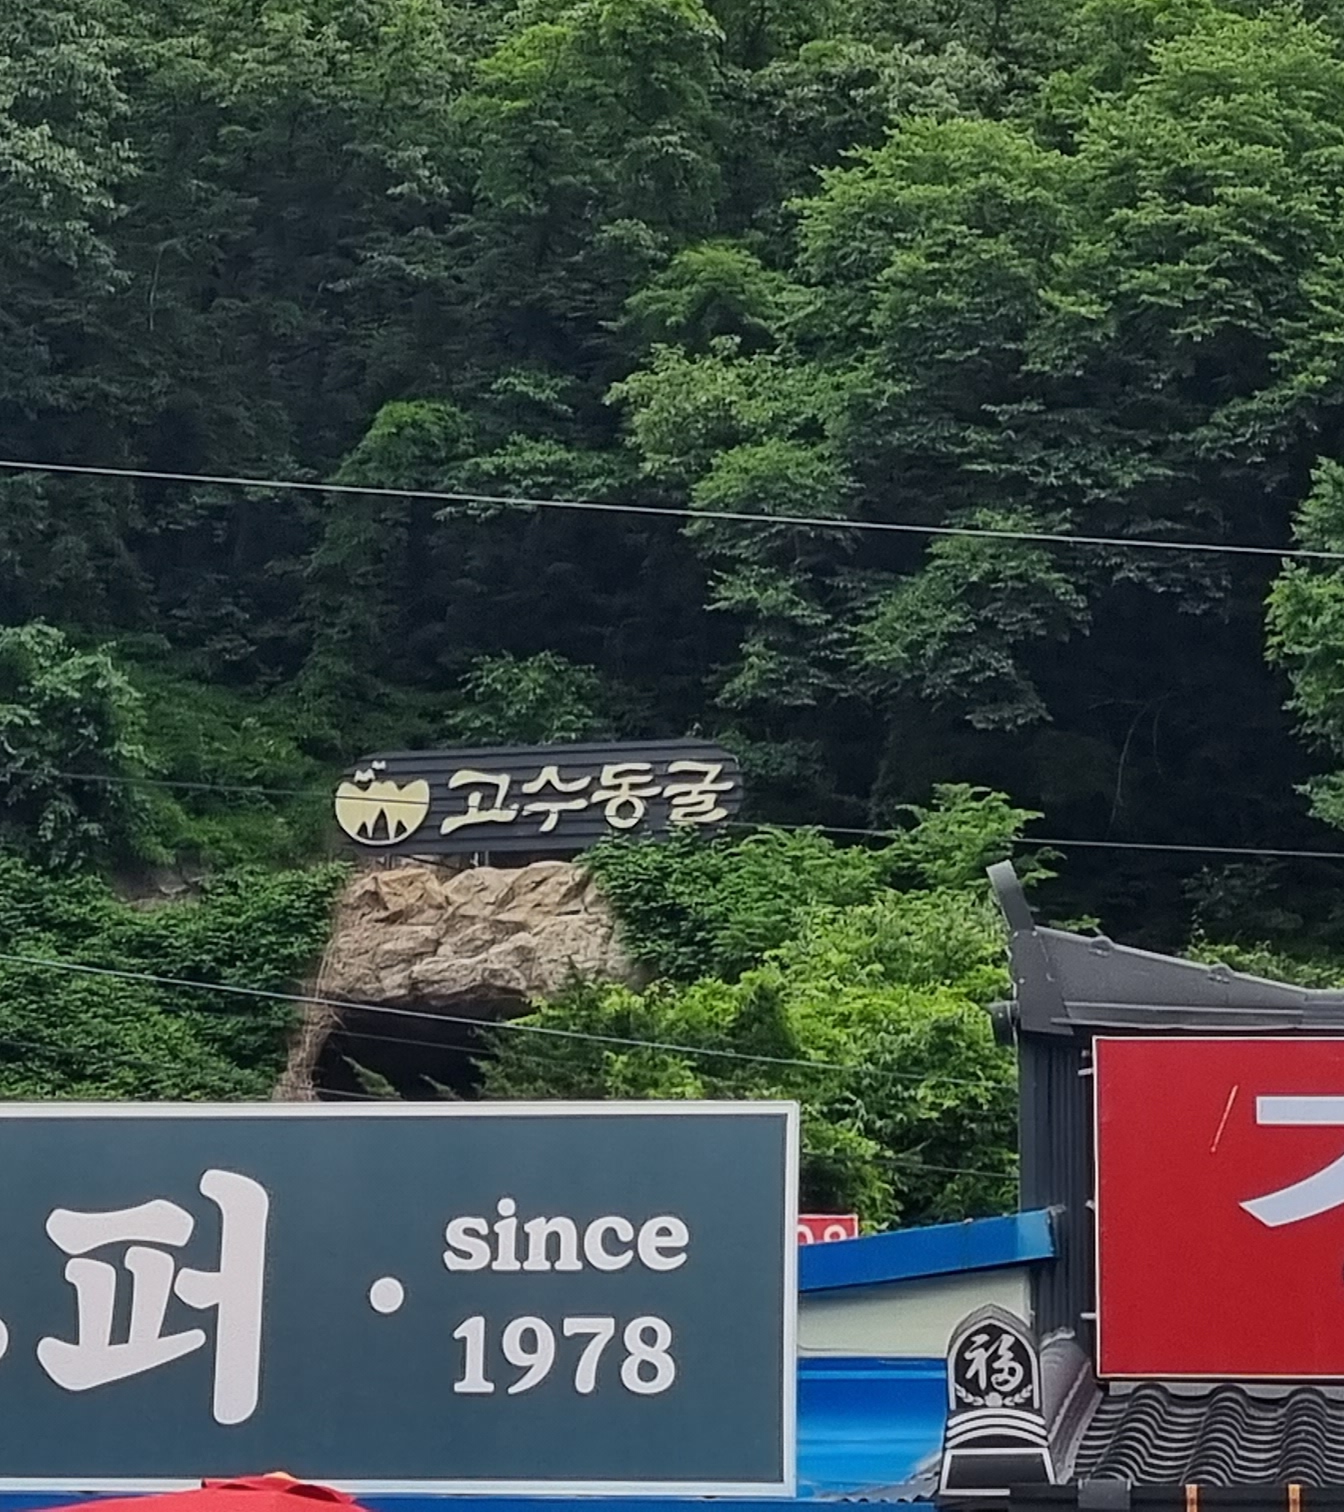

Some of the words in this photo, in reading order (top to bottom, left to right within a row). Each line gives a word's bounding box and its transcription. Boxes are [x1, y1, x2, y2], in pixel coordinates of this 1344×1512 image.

[439, 759, 735, 836] 고수동굴
[443, 1197, 689, 1271] since
[453, 1316, 676, 1394] 1978
